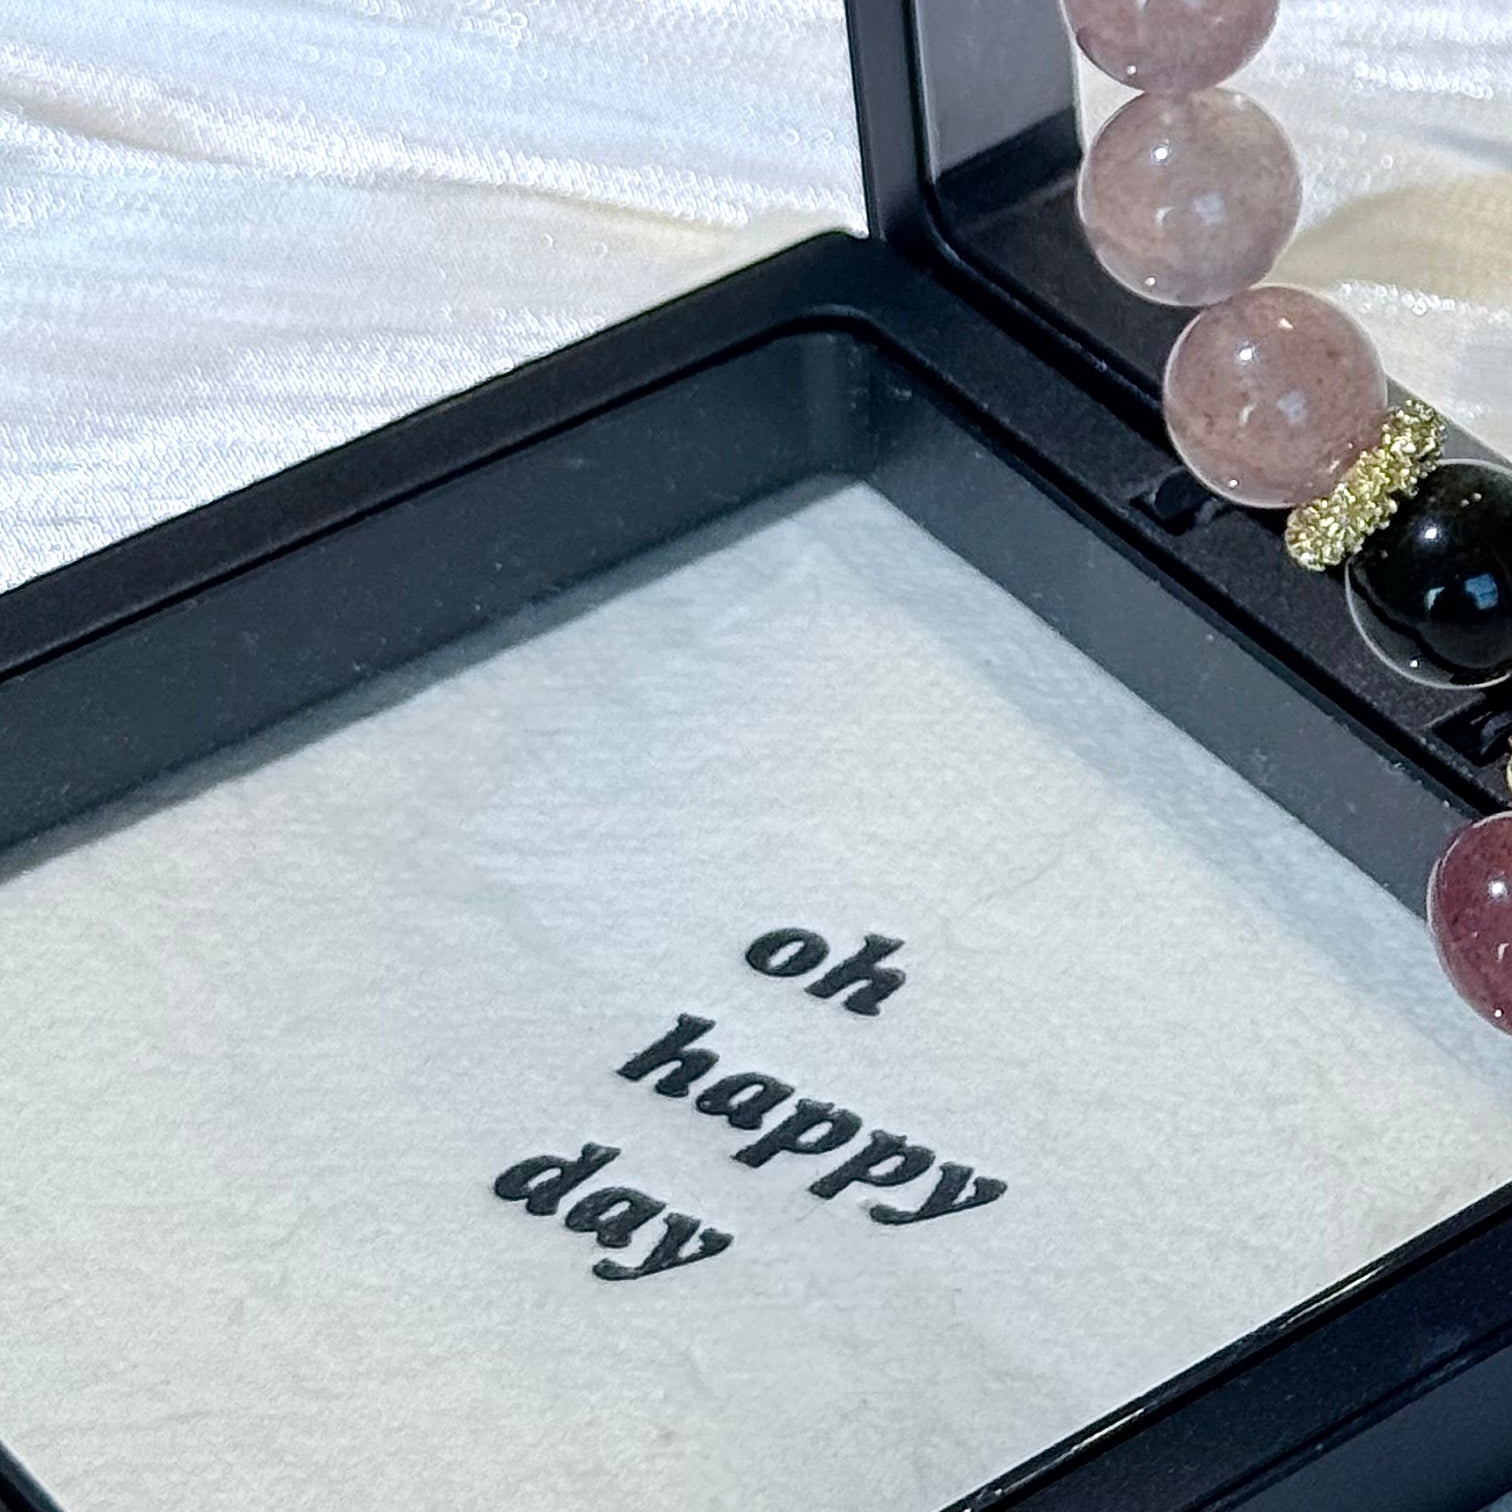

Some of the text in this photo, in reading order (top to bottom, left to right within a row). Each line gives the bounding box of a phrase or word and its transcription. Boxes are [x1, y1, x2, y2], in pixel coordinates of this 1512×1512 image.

[744, 927, 907, 1017] oh
[615, 1012, 1009, 1227] happy
[492, 1142, 734, 1282] day
